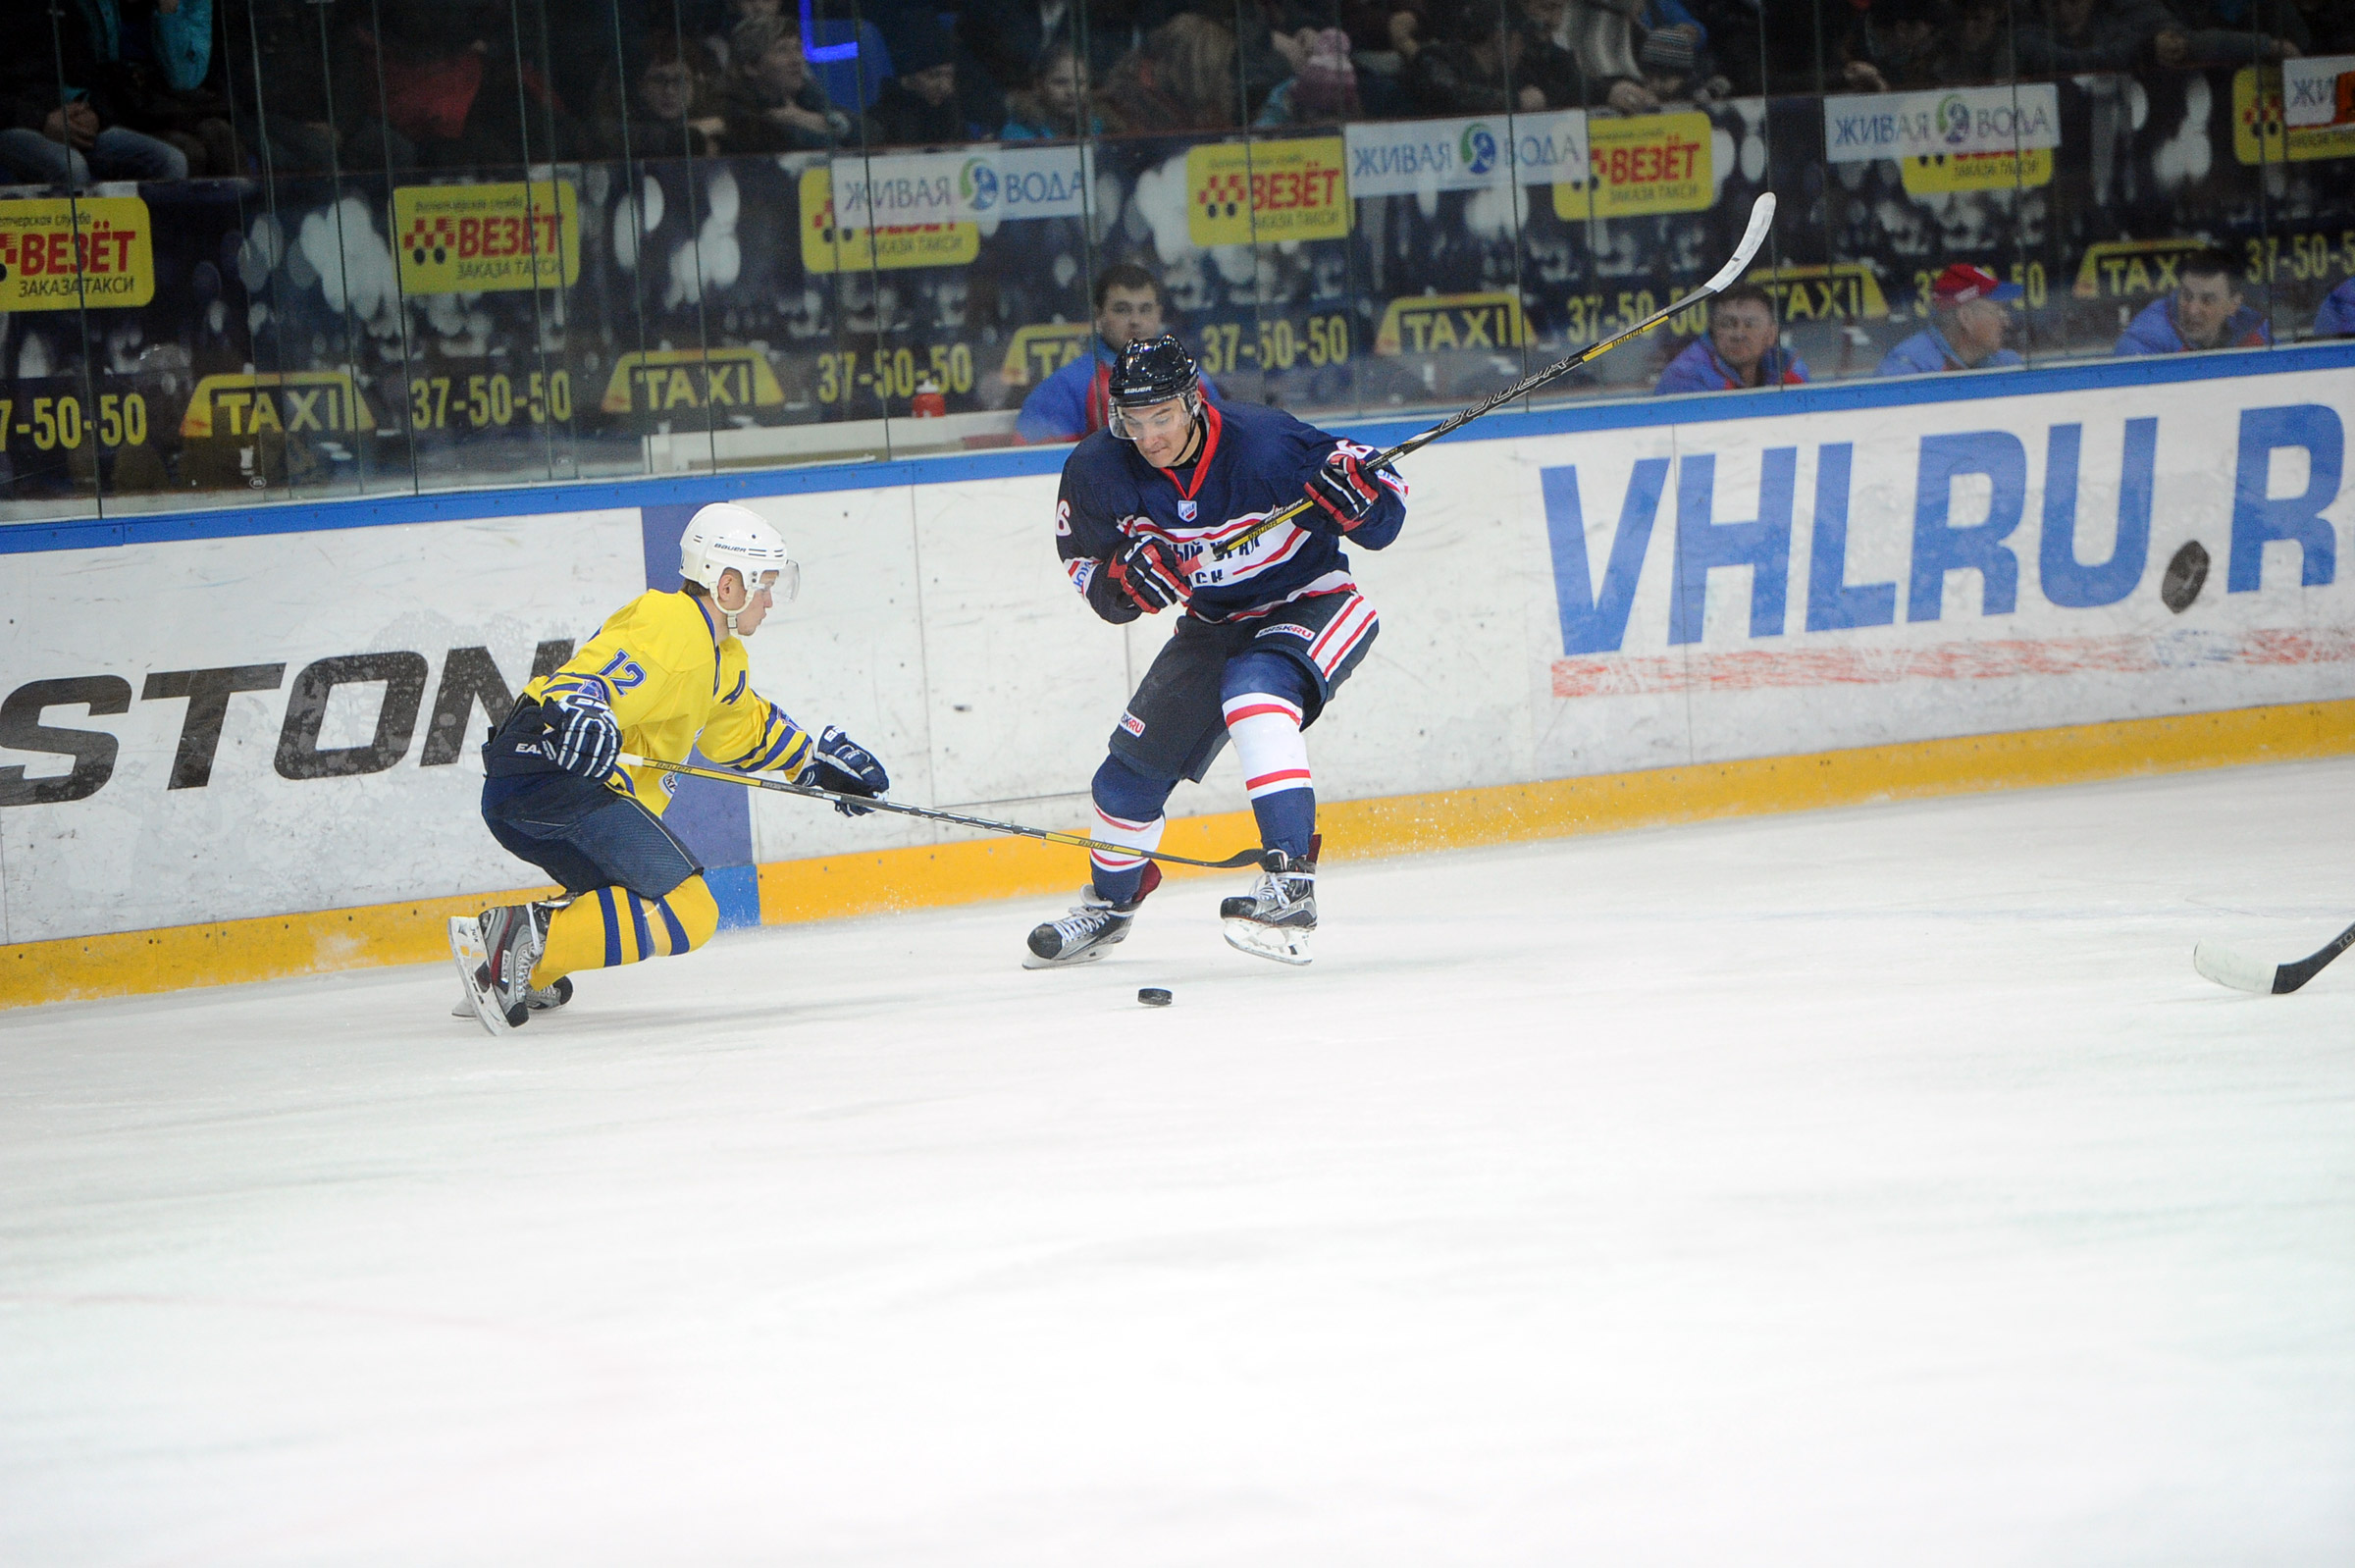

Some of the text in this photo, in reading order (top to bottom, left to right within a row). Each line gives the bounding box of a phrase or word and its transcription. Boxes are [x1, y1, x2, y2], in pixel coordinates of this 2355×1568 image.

[1835, 105, 2052, 145] ЖИВАЯ ВОДА
[1353, 142, 1450, 178] ЖИВАЯ
[1503, 134, 1581, 168] ВОДА
[1610, 135, 1701, 185] ВЕЗЁТ
[845, 170, 1085, 211] ЖИВАЯ ВОДА
[1251, 161, 1340, 211] ВЕЗЁТ
[21, 220, 136, 276] ВЕЗЁТ
[458, 203, 564, 258] ВЕЗЁТ
[2101, 252, 2190, 295] TAX
[1201, 315, 1348, 375] 37-50-50
[1403, 306, 1507, 354] TAXI
[636, 364, 751, 412] TAXI
[817, 341, 973, 404] 37-50-50
[1124, 386, 1153, 394] BAUER
[216, 387, 341, 436] TAXI
[413, 369, 572, 429] 37-50-50
[597, 648, 648, 698] 12
